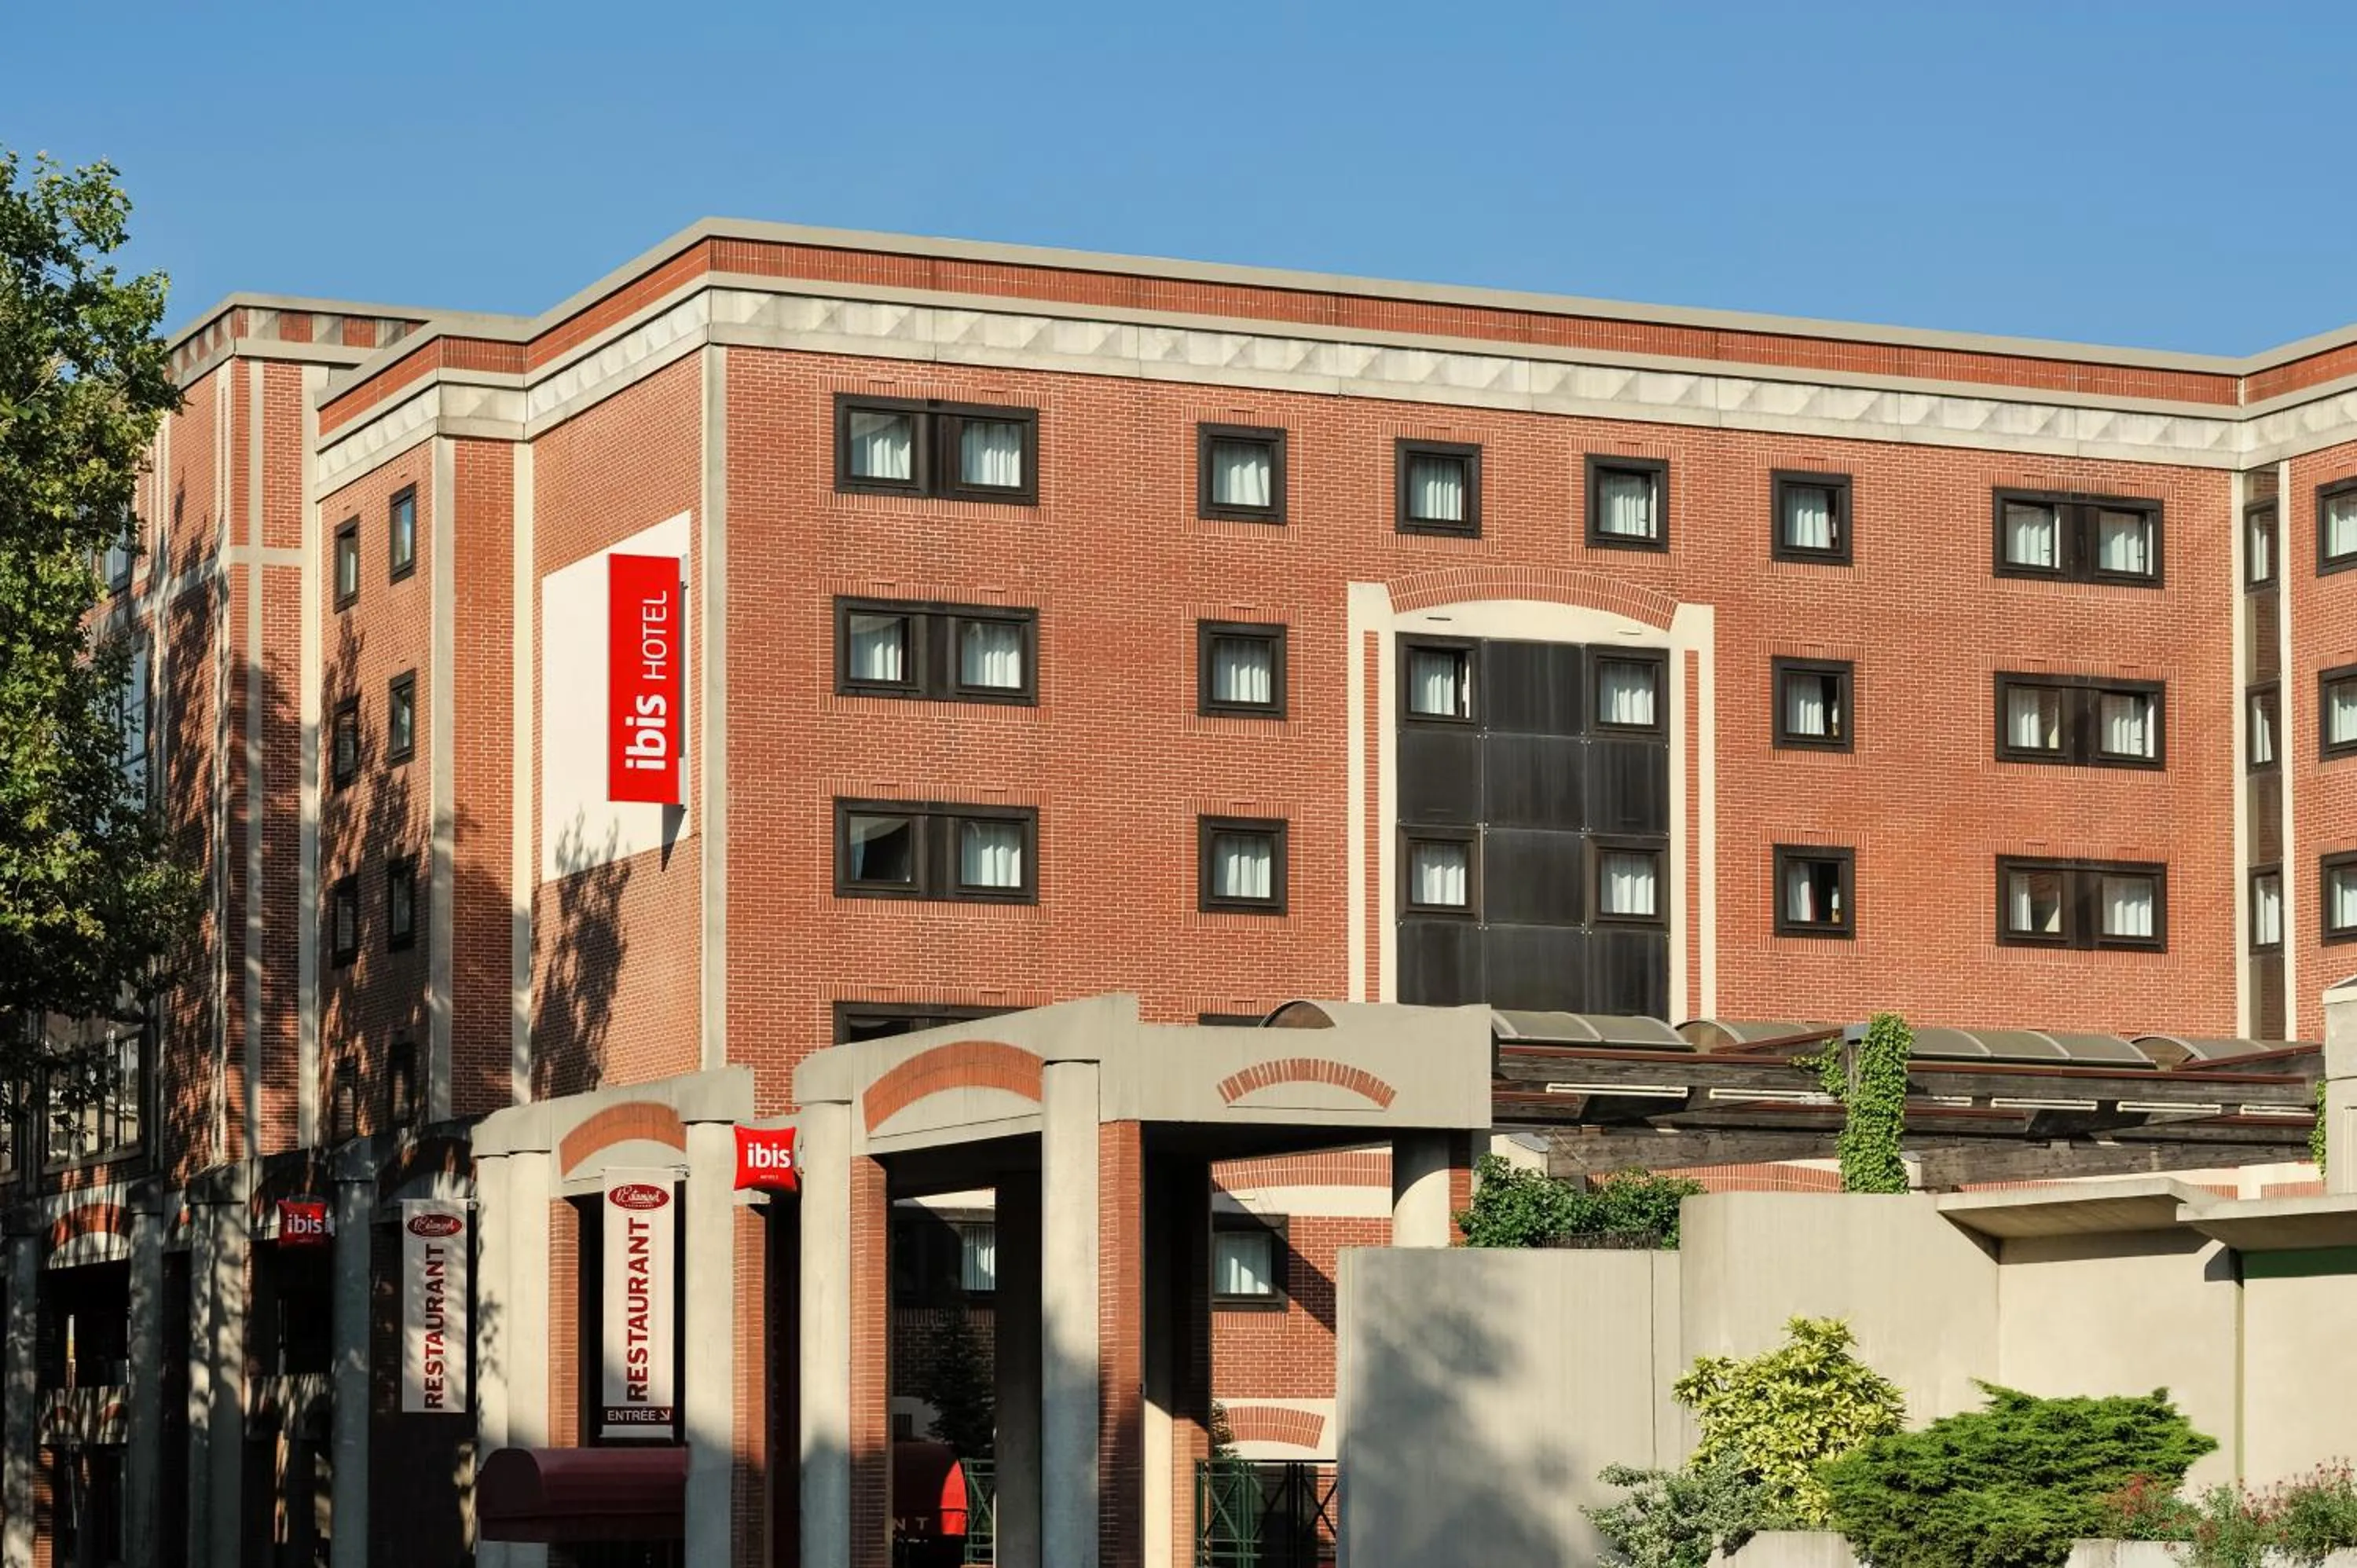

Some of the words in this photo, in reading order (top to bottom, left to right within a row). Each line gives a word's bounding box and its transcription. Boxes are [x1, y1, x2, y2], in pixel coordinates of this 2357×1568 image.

[642, 590, 667, 680] HOTEL
[625, 694, 666, 770] ibis
[747, 1142, 791, 1169] ibis
[287, 1213, 324, 1234] ibis
[424, 1244, 445, 1409] RESTAURANT
[626, 1217, 650, 1402] RESTAURANT
[607, 1407, 656, 1421] ENTRÉE
